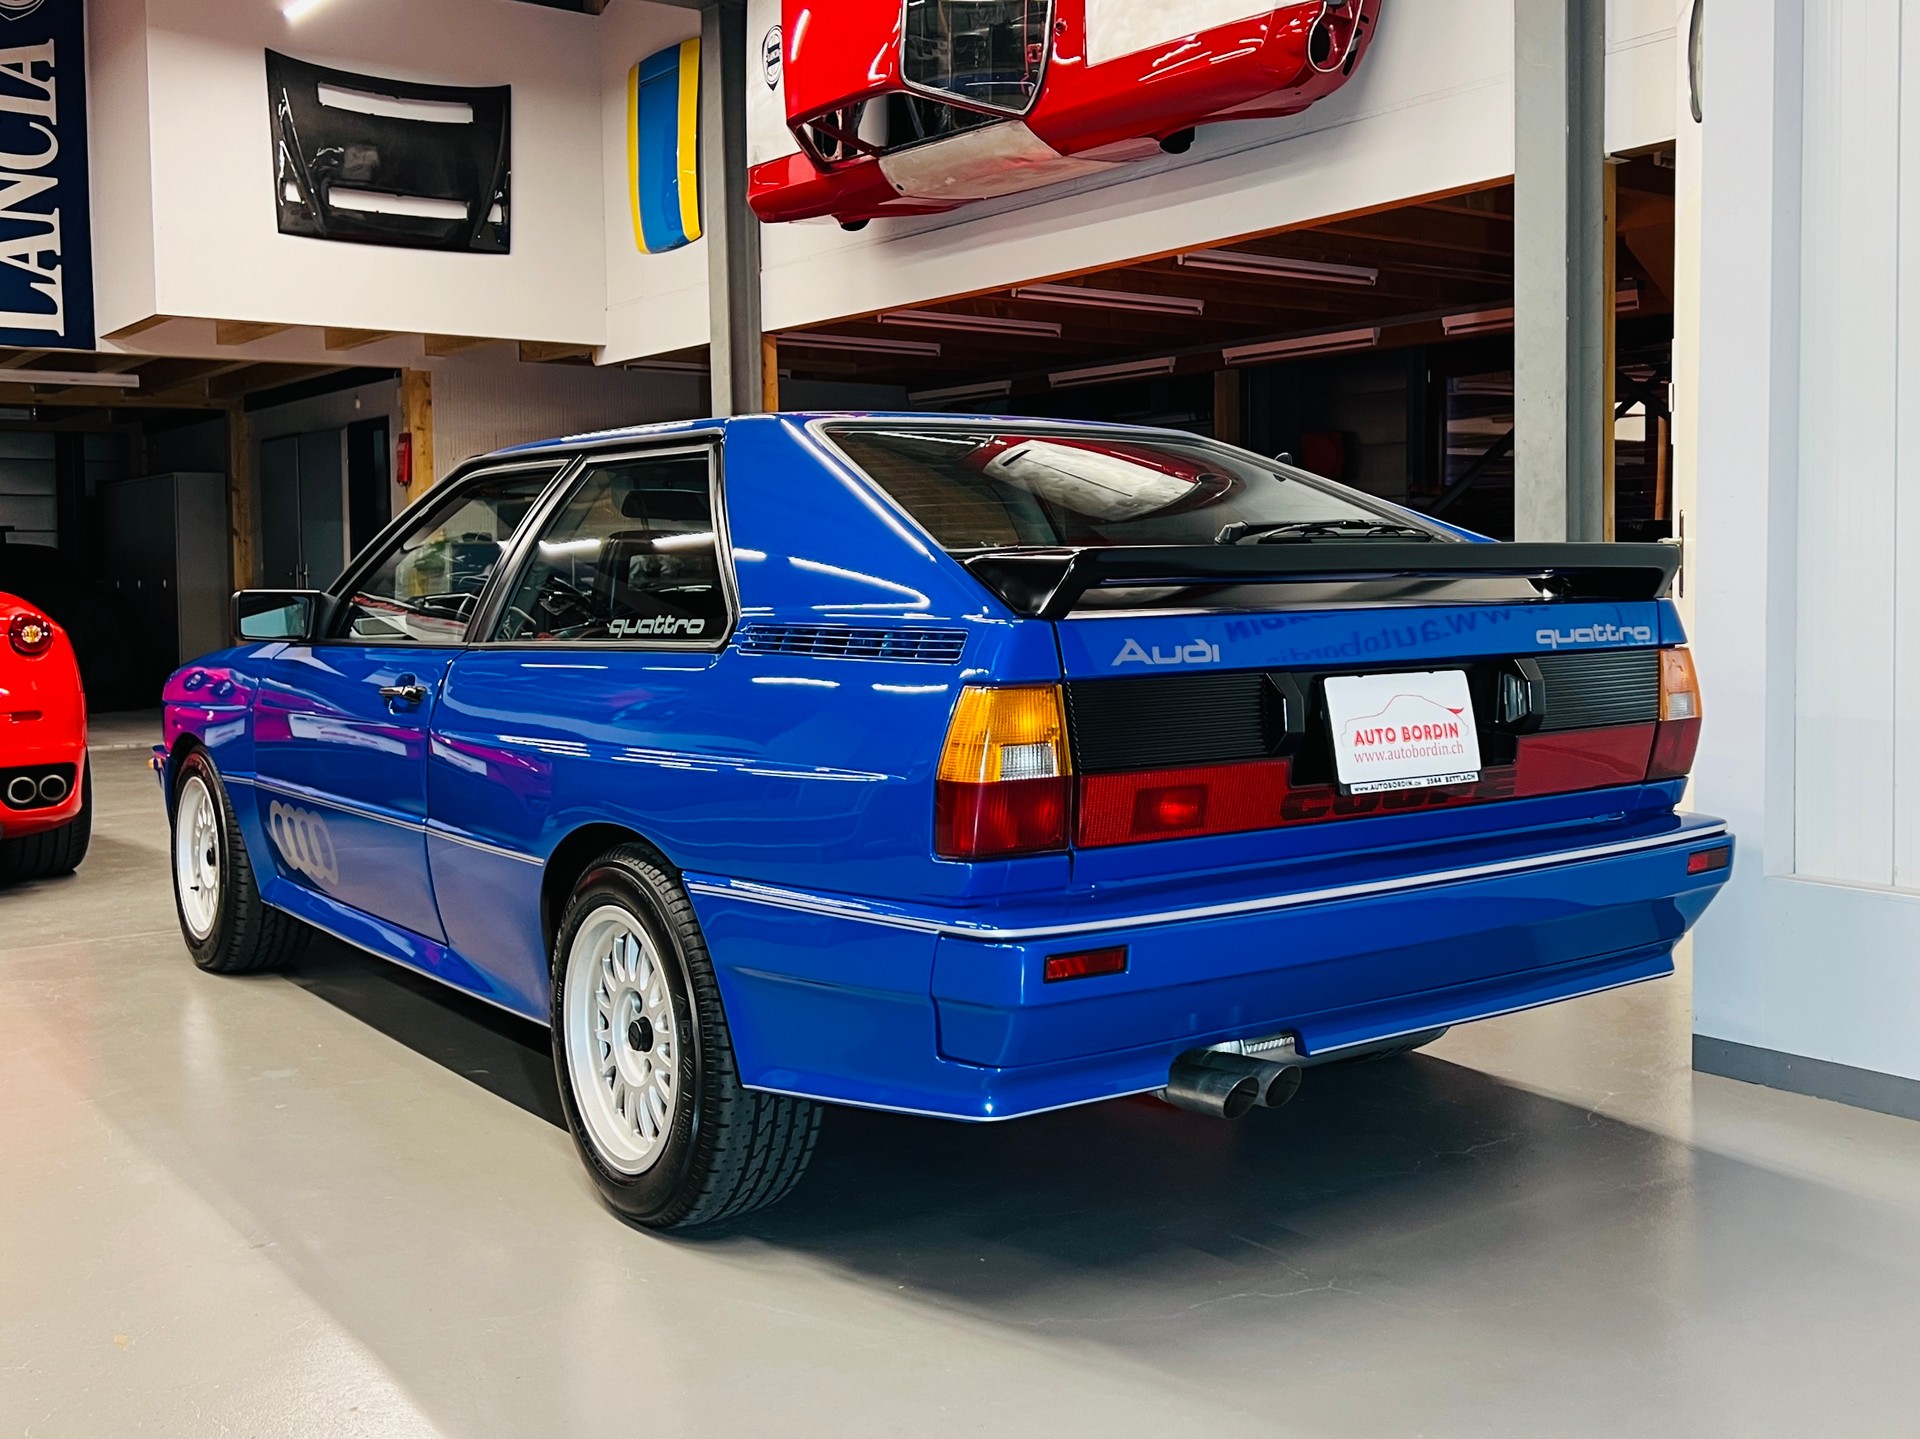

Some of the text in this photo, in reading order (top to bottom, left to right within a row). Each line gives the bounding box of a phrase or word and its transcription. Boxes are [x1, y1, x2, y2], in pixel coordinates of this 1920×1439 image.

[0, 38, 64, 336] LANCIA
[608, 615, 705, 638] quattro
[1536, 624, 1651, 649] quattro
[1110, 638, 1220, 666] Audi
[1354, 722, 1460, 747] AUTO BORDIN
[1354, 740, 1465, 764] www.autobordin.ch
